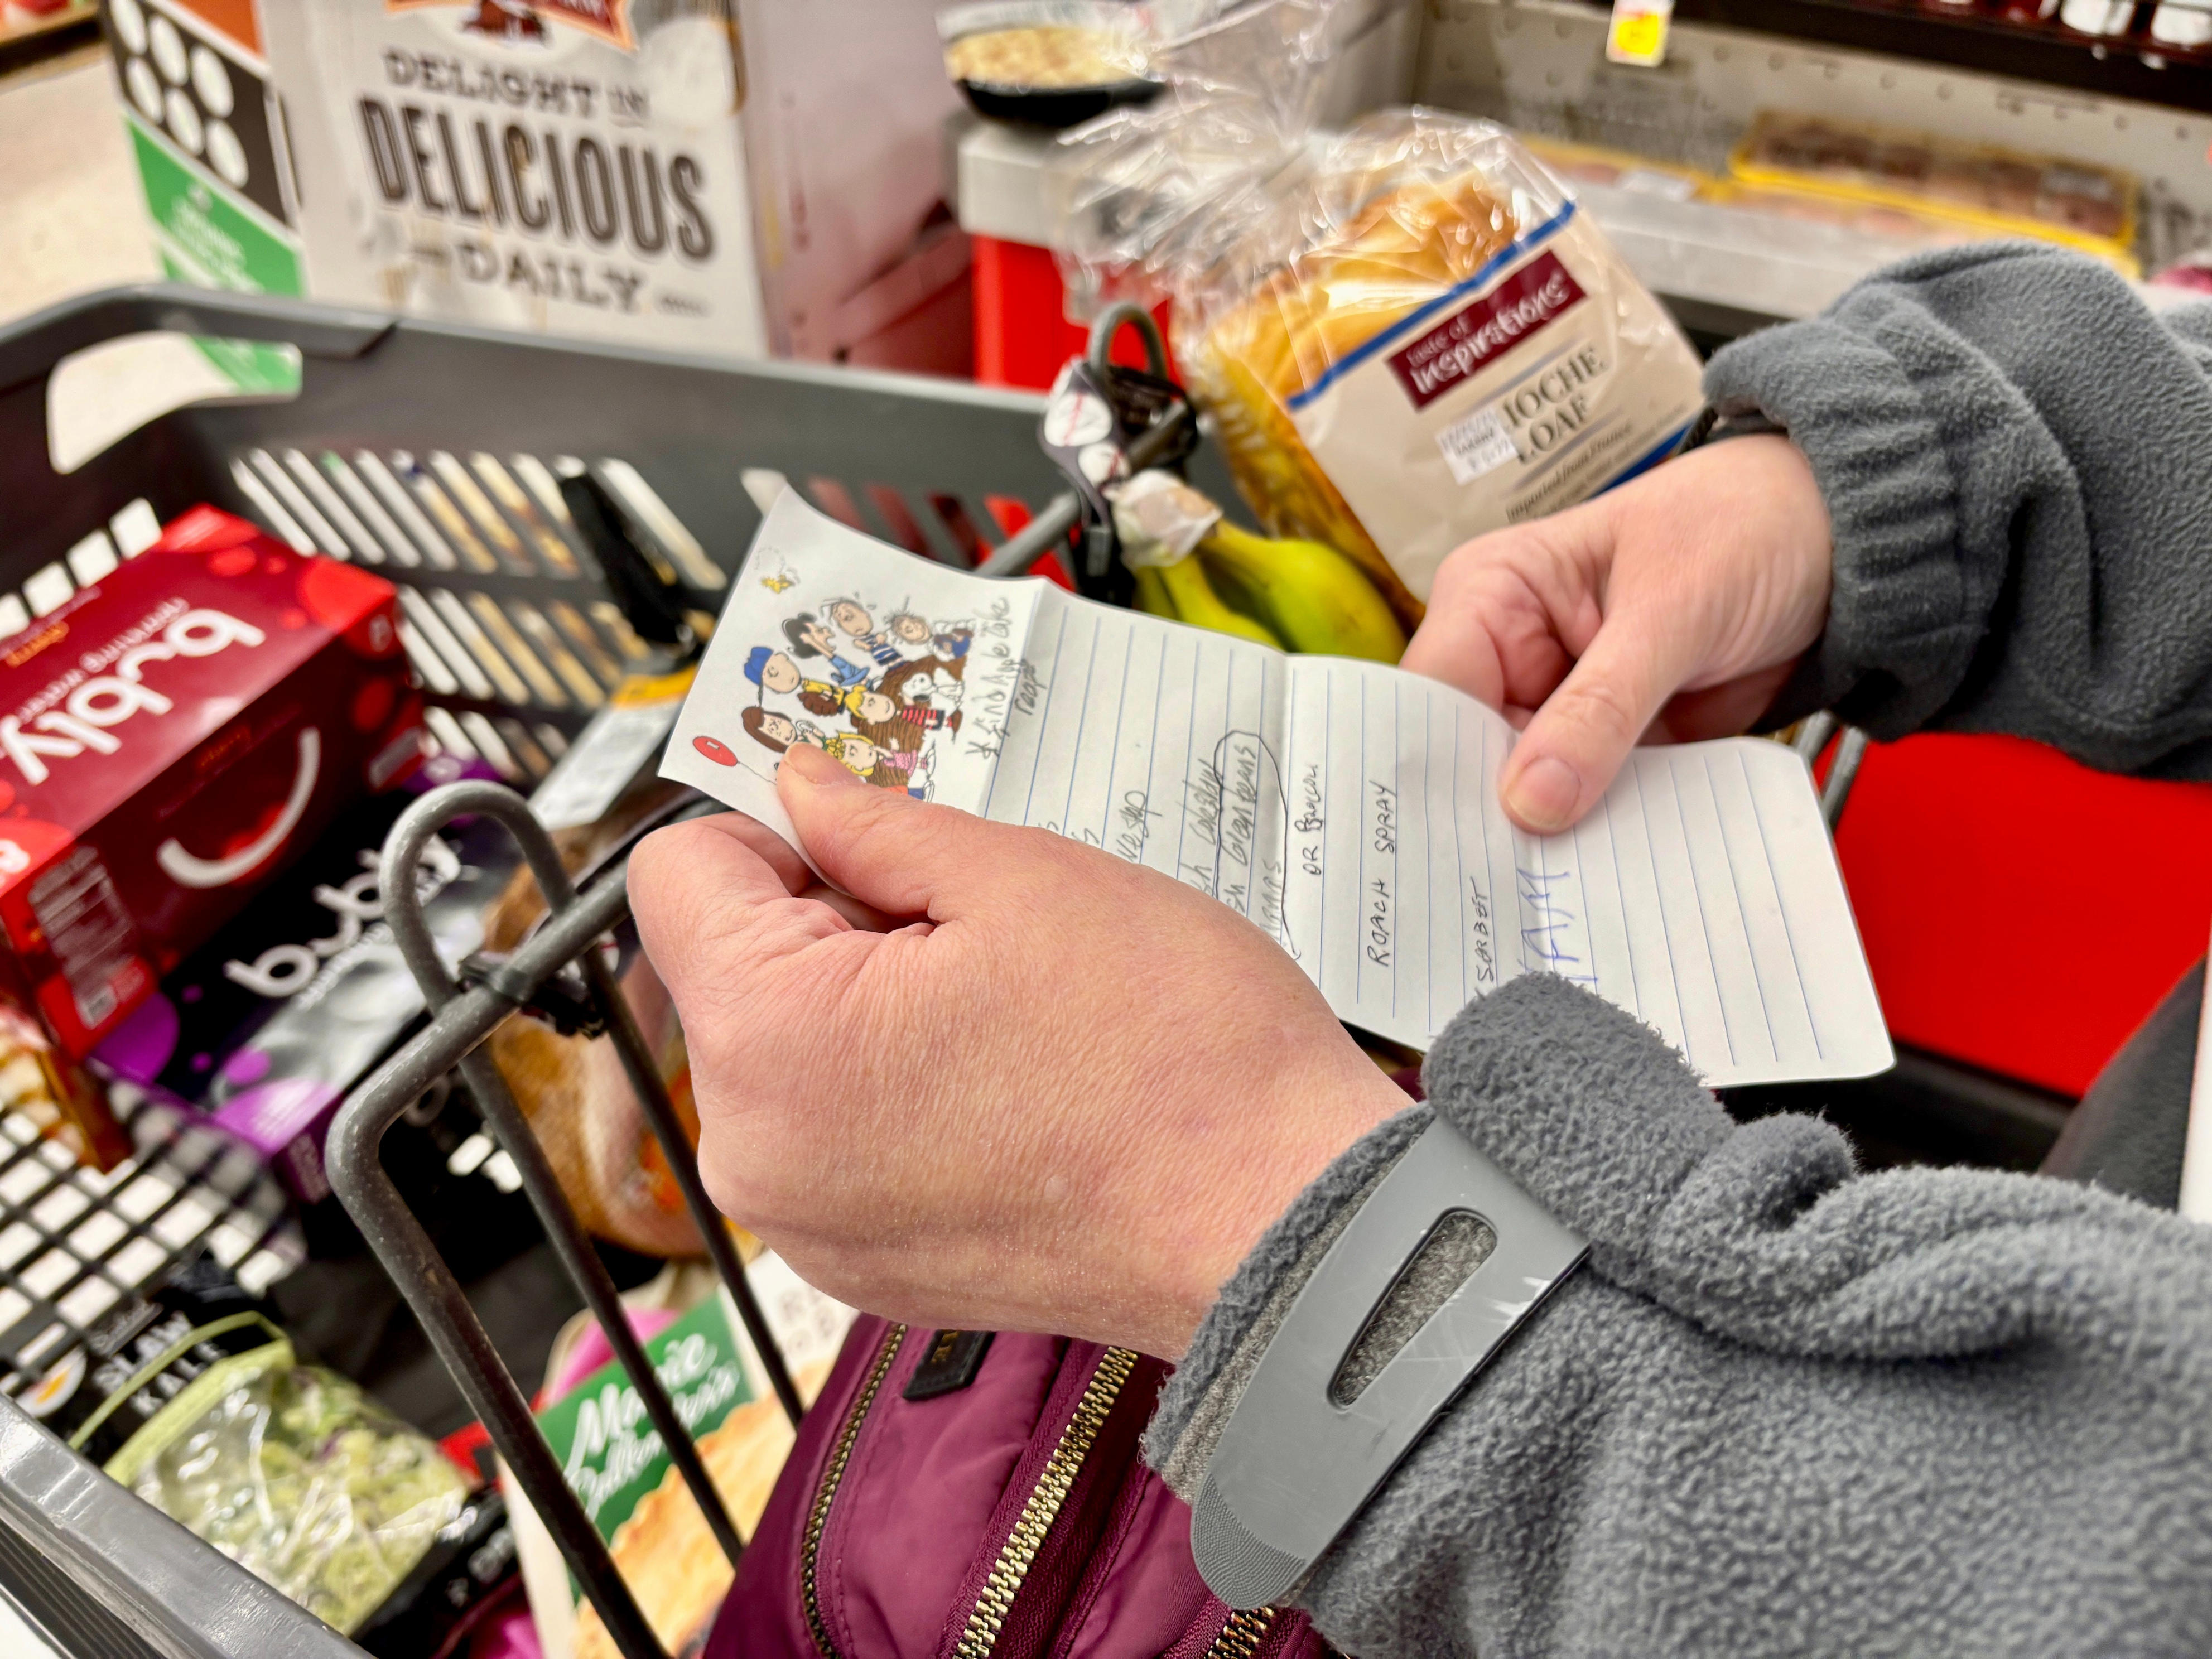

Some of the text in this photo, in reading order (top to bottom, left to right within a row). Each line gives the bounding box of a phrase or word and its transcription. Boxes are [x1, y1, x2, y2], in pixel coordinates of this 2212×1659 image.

[383, 47, 595, 117] DELIGHT
[355, 97, 714, 261] DELICIOUS
[457, 241, 648, 314] DAILY
[1503, 346, 1608, 427] IOCHE
[0, 609, 266, 785] bubly
[1302, 846, 1322, 876] OR
[1367, 780, 1396, 967] ROACH SPRAY
[1470, 876, 1493, 982] SORBET
[563, 1333, 717, 1479] Maie
